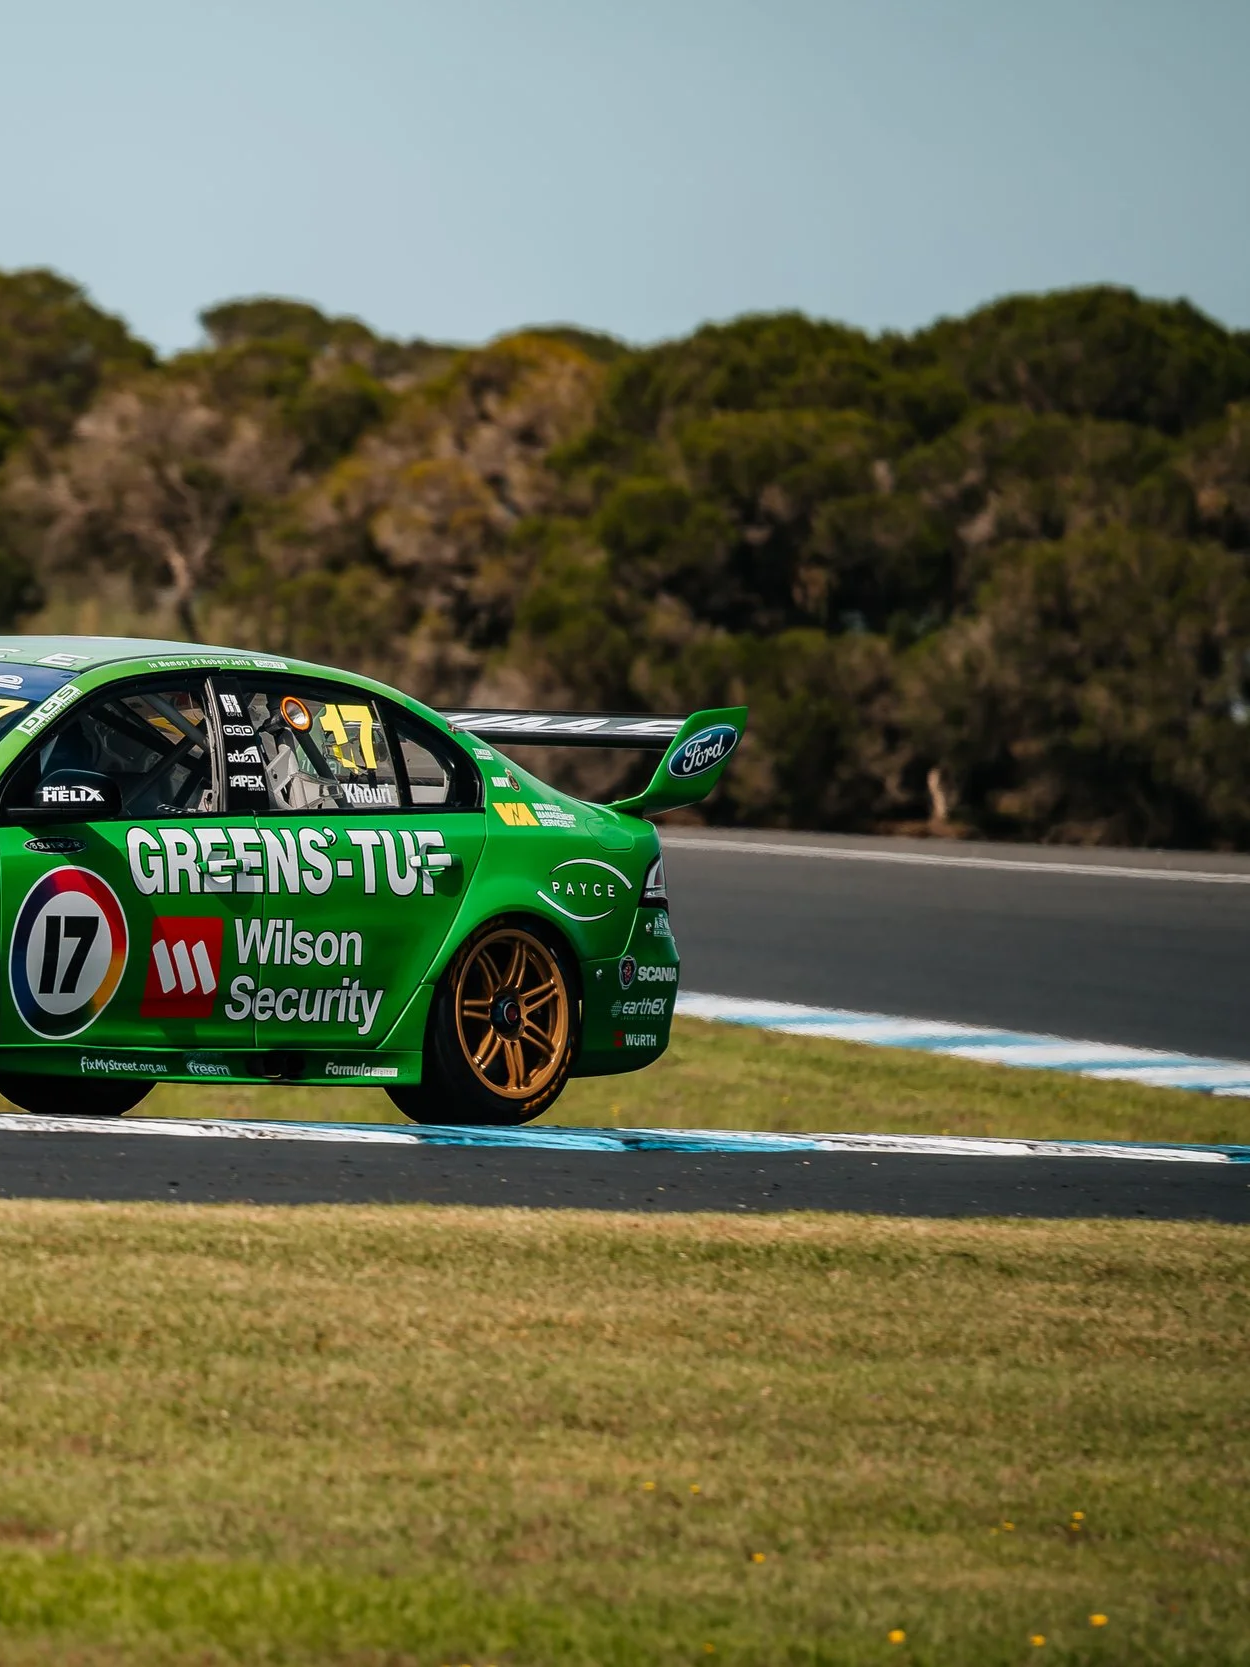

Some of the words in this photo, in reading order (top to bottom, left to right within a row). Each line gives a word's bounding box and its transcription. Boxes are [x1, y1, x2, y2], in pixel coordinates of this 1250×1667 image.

[20, 685, 76, 732] DGS
[319, 703, 378, 770] 17
[682, 733, 726, 773] Ford
[42, 787, 105, 802] HELIX
[340, 783, 393, 804] Khouri
[551, 881, 616, 898] PAYCE
[38, 915, 100, 994] 17
[234, 917, 364, 966] Wilson
[637, 965, 677, 982] SCANIA
[224, 974, 385, 1036] Security
[186, 1059, 232, 1076] freem
[325, 1060, 372, 1077] Formula
